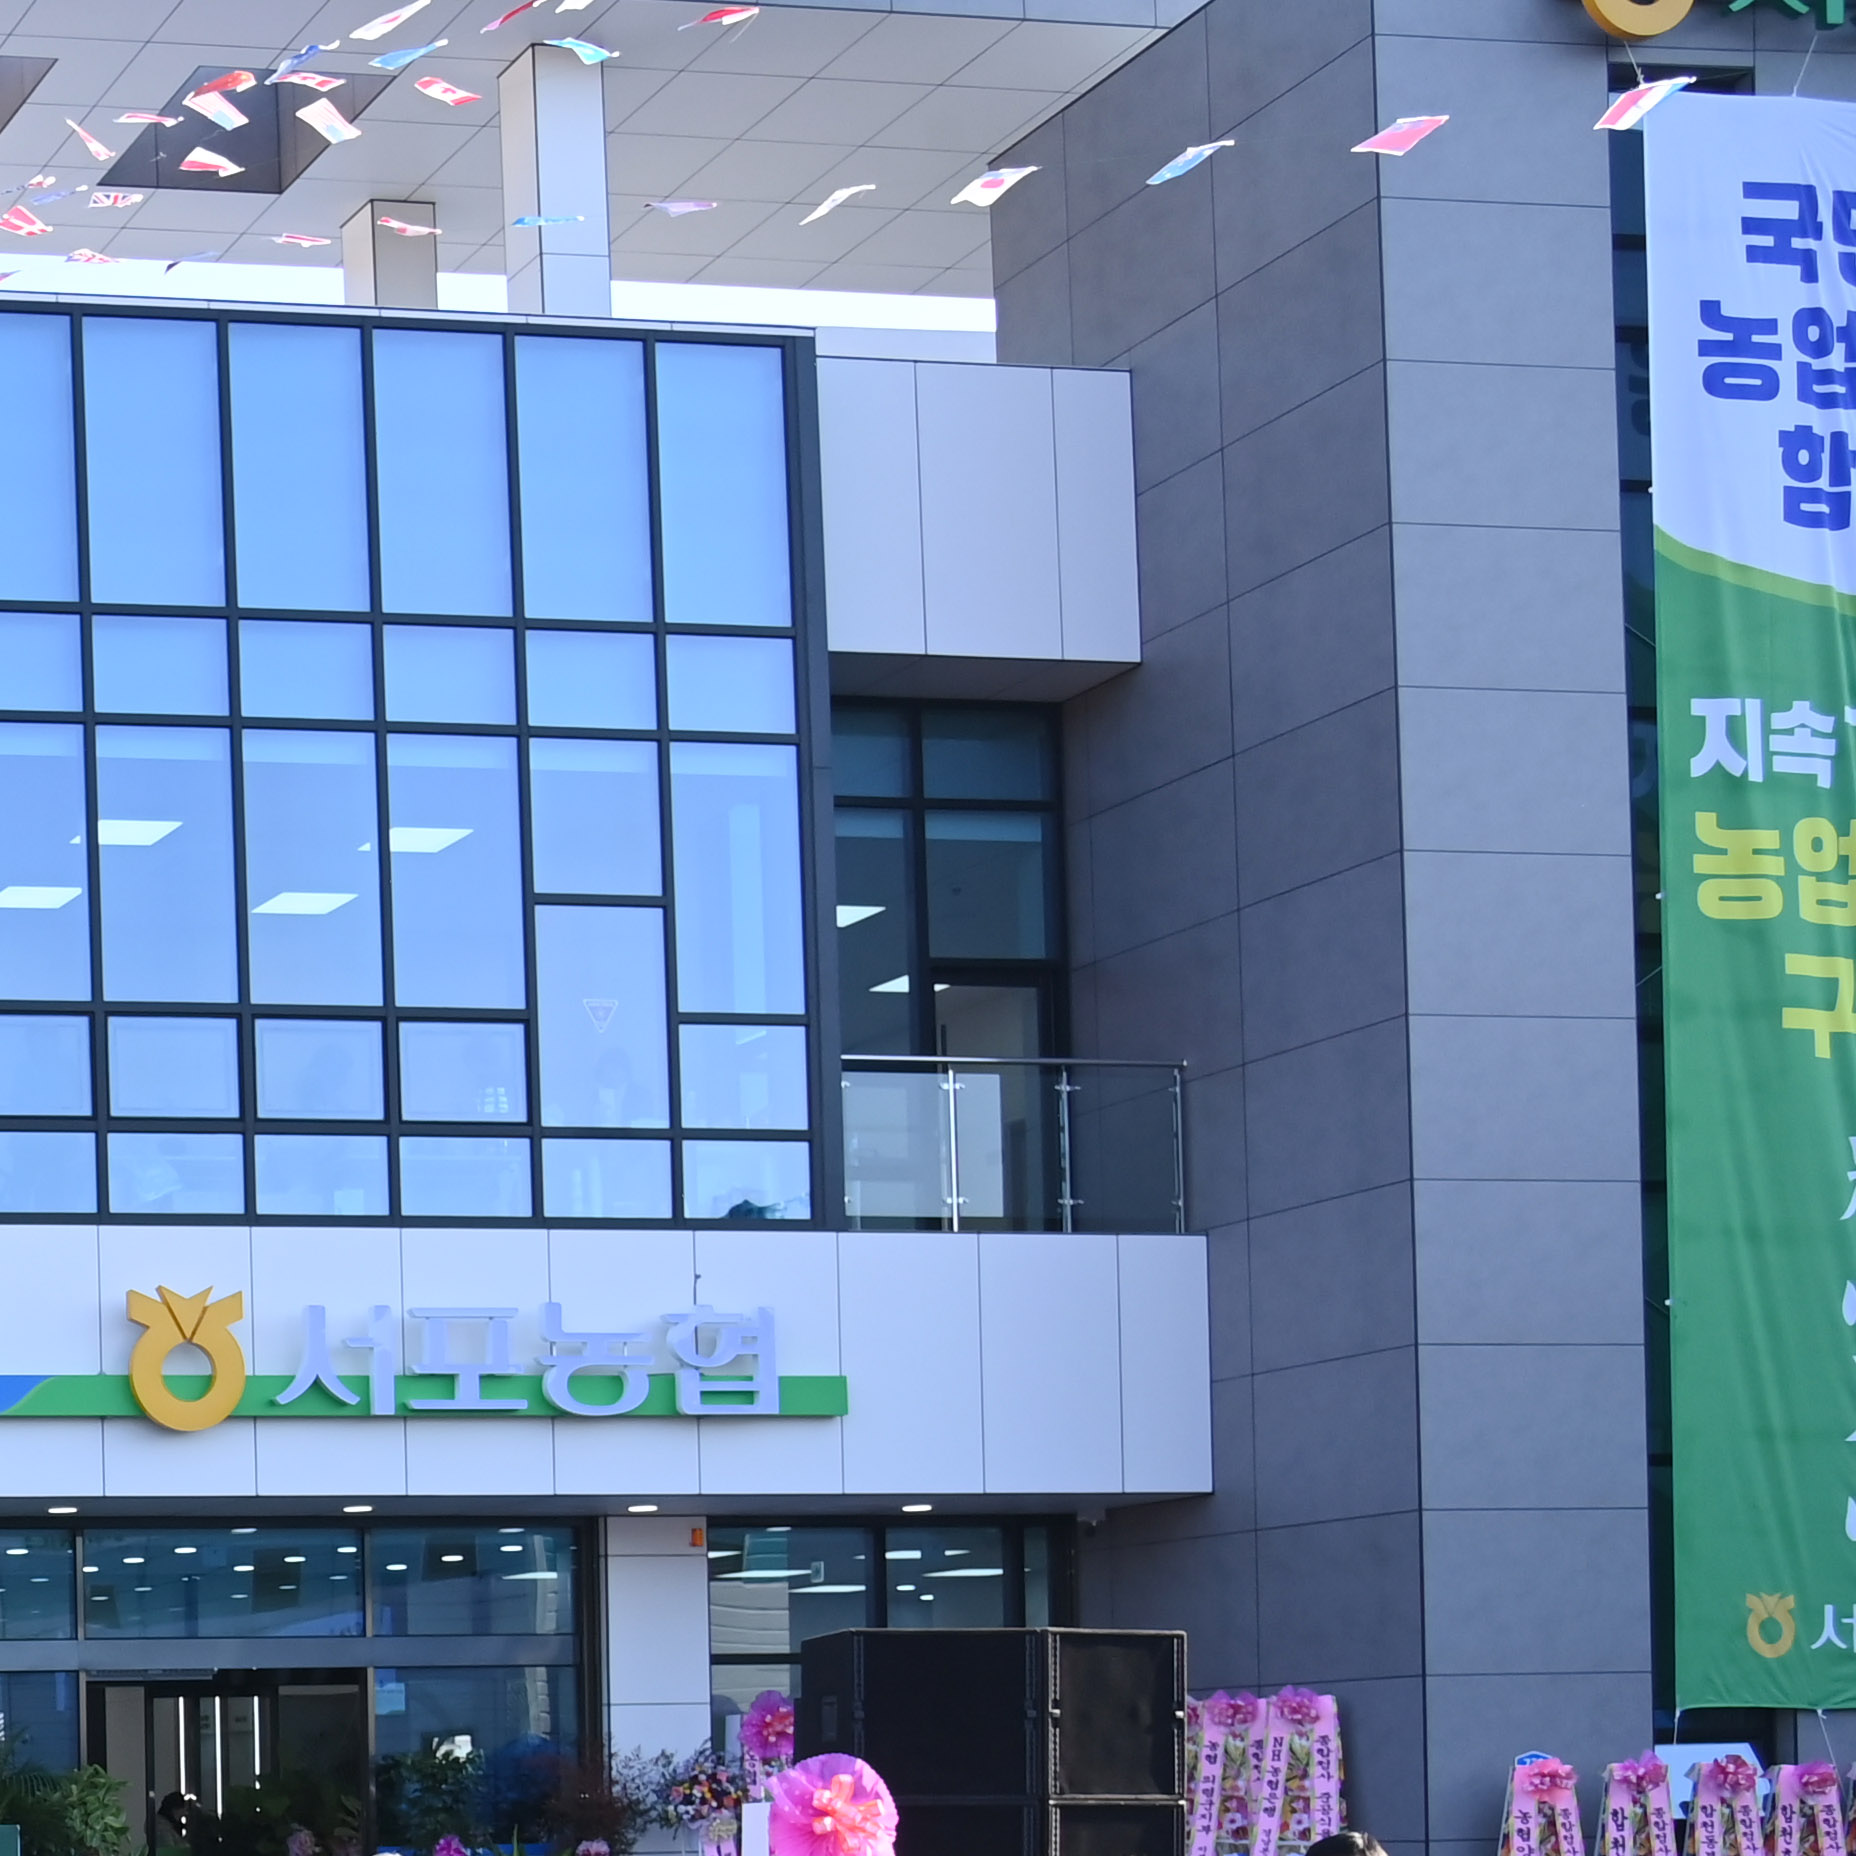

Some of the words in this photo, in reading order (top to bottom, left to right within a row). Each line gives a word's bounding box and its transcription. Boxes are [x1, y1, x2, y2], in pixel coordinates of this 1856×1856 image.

[1690, 698, 1856, 789] 지속
[274, 1301, 780, 1417] 서포농협
[1272, 1736, 1284, 1762] NH
